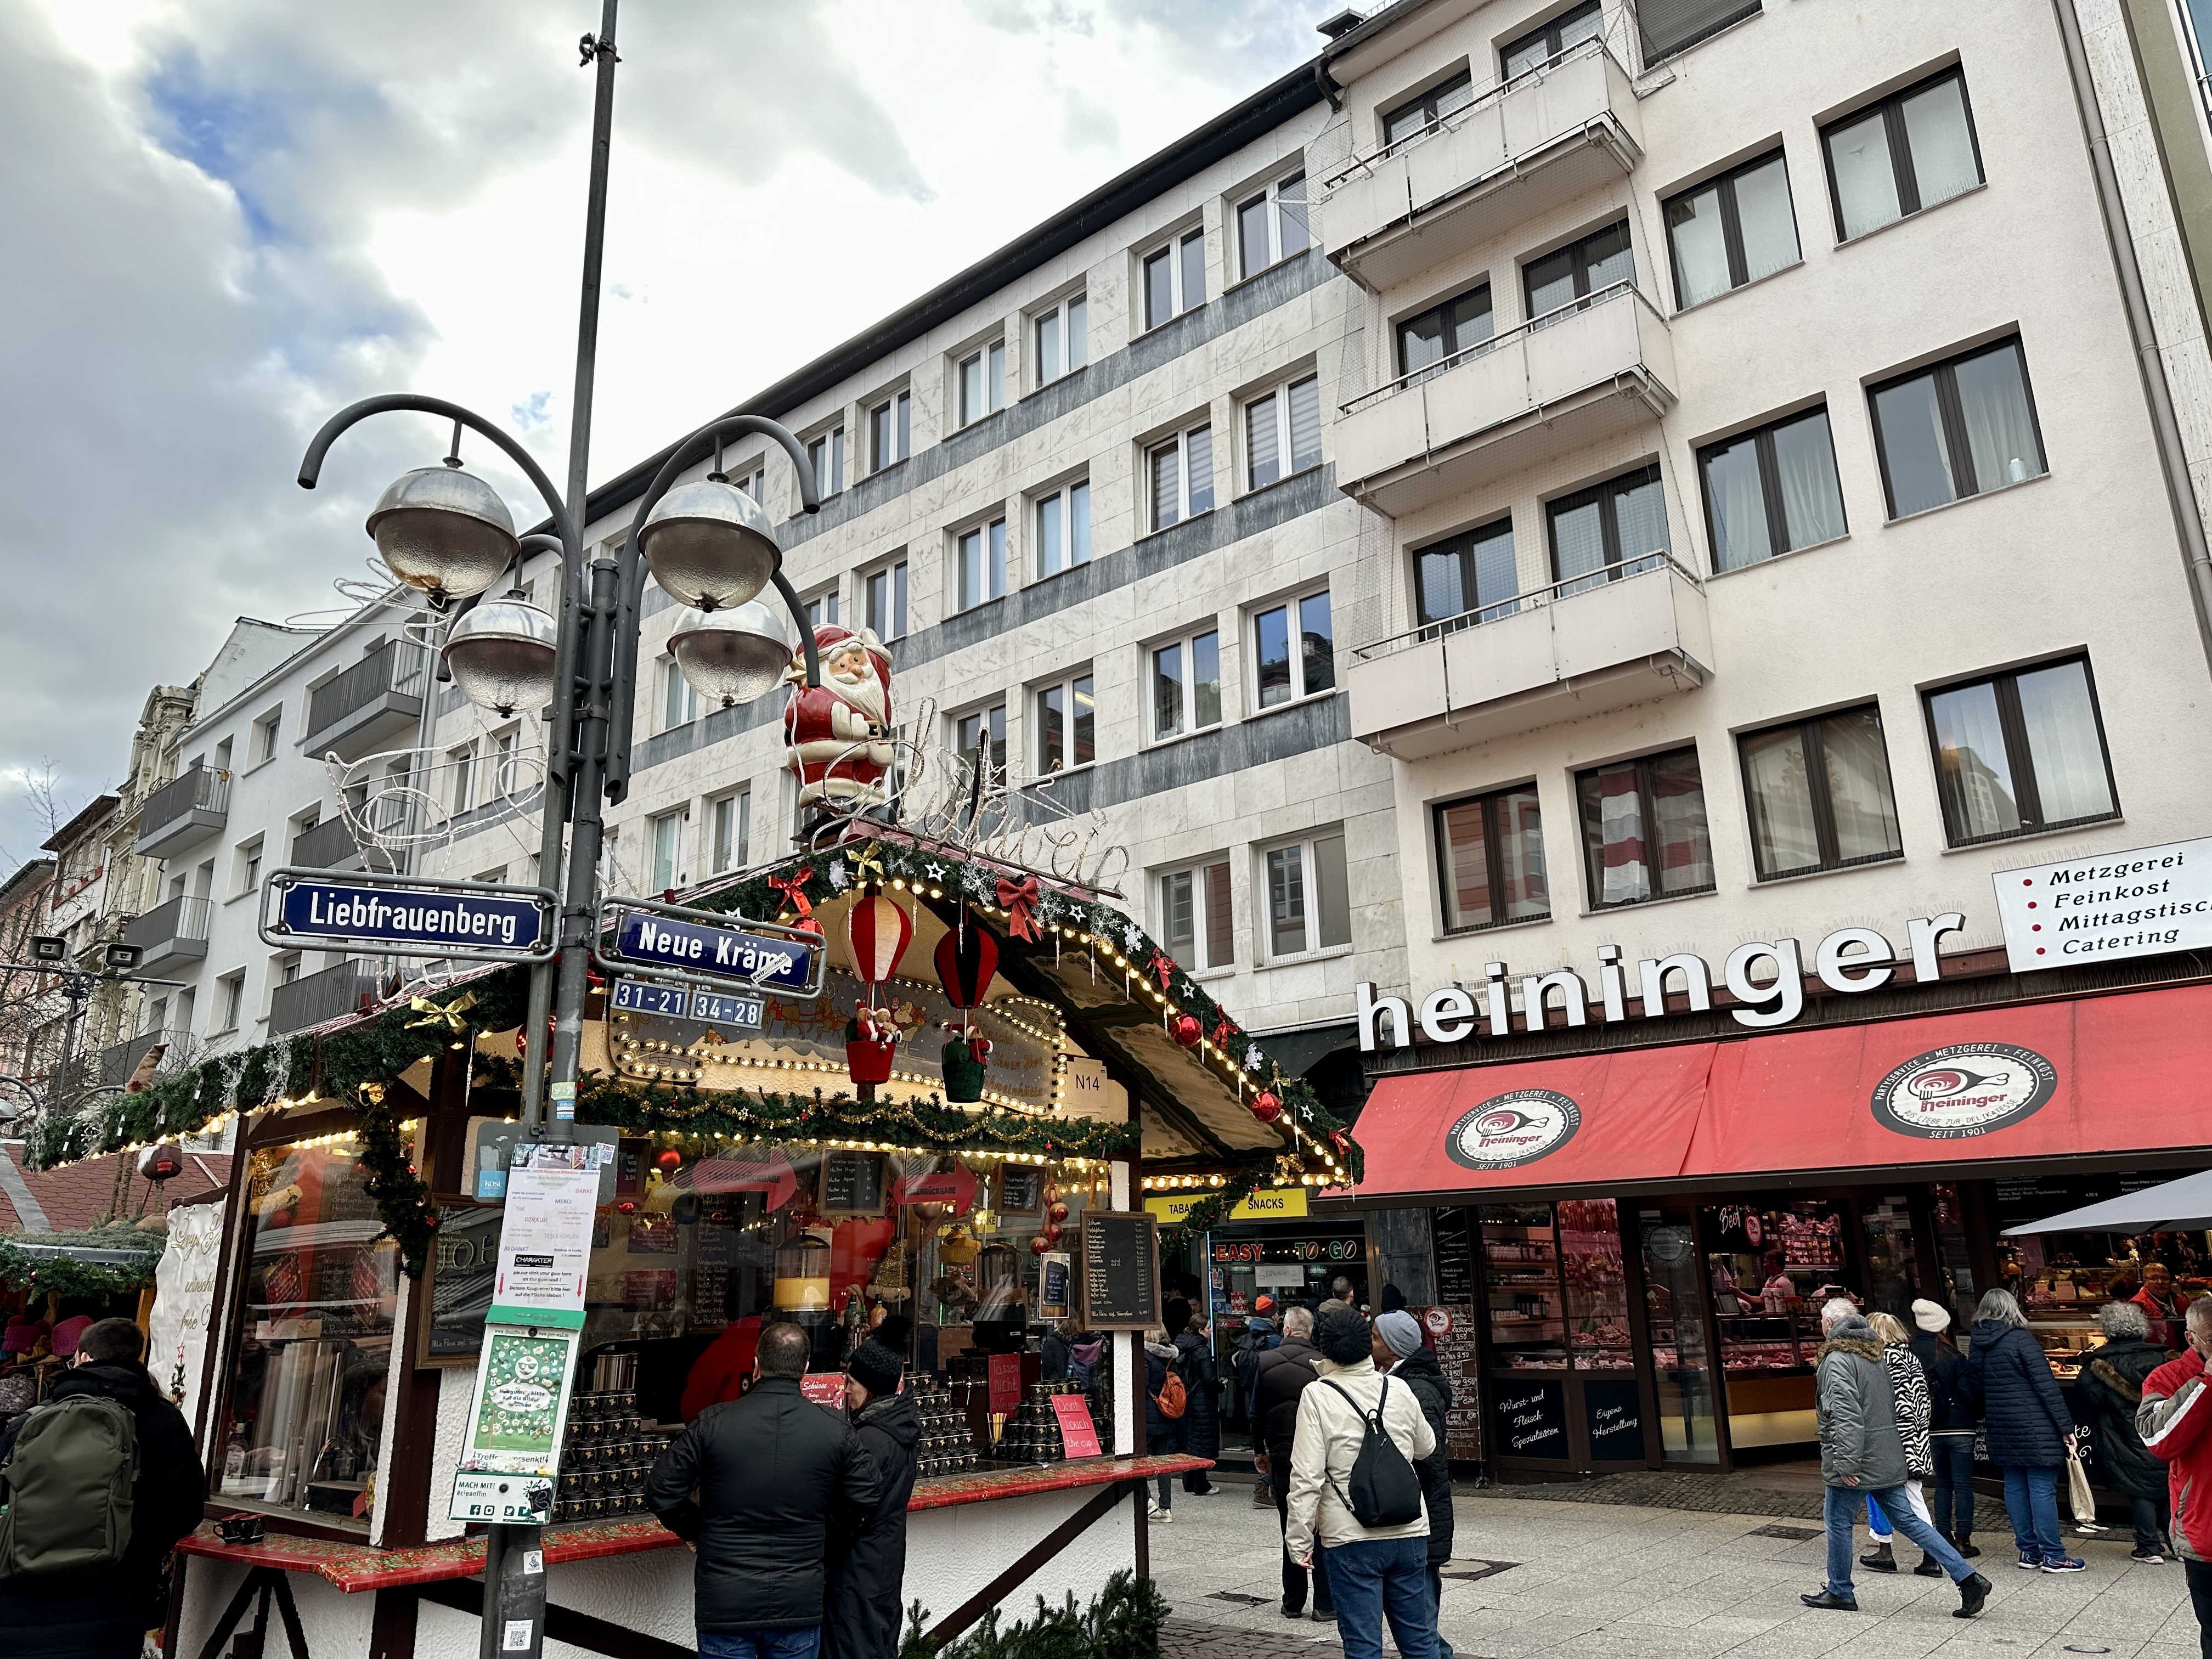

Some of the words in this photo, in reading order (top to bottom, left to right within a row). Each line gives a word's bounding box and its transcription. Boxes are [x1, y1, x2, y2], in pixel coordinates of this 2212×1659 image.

[2050, 852, 2183, 885] Metzgerei
[2055, 879, 2170, 909] Feinkost
[309, 893, 517, 941] Liebfrauenberg
[2059, 900, 2212, 932] Mittagstisc
[639, 922, 703, 958] Neue
[2063, 929, 2179, 954] Catering
[1357, 912, 1966, 1050] heininger
[618, 985, 682, 1013] 31-21
[697, 998, 759, 1024] 34-28
[1075, 1074, 1099, 1091] N14
[1875, 1059, 1921, 1101] PARTYSERVICE
[1935, 1044, 1998, 1058] METZGEREI
[2013, 1048, 2054, 1081] FEINKOST
[1450, 1101, 1492, 1135] PARTYSERVICE
[1504, 1091, 1549, 1101] METZGEREI
[1557, 1097, 1579, 1126] FEINKOST
[1917, 1115, 1940, 1125] LIEBE
[1966, 1098, 2019, 1124] DELIKATESSE
[1920, 1094, 2007, 1113] heininger
[1479, 1135, 1543, 1148] heininger
[1929, 1130, 1954, 1138] SEIT
[1961, 1126, 1986, 1137] 1901
[1248, 1198, 1284, 1210] SNACKS
[1216, 1244, 1263, 1261] EASY
[990, 1359, 1018, 1375] Tassen
[994, 1377, 1017, 1392] nicht
[1499, 1398, 1529, 1413] Wurst-
[1531, 1389, 1544, 1403] und
[1059, 1415, 1090, 1430] Touch
[1514, 1410, 1543, 1427] Fleisch-
[1596, 1406, 1622, 1419] Eigene
[1511, 1427, 1559, 1449] Spezialitäten
[1593, 1418, 1638, 1438] Herstellung
[1065, 1436, 1079, 1447] the
[1081, 1440, 1092, 1448] cup
